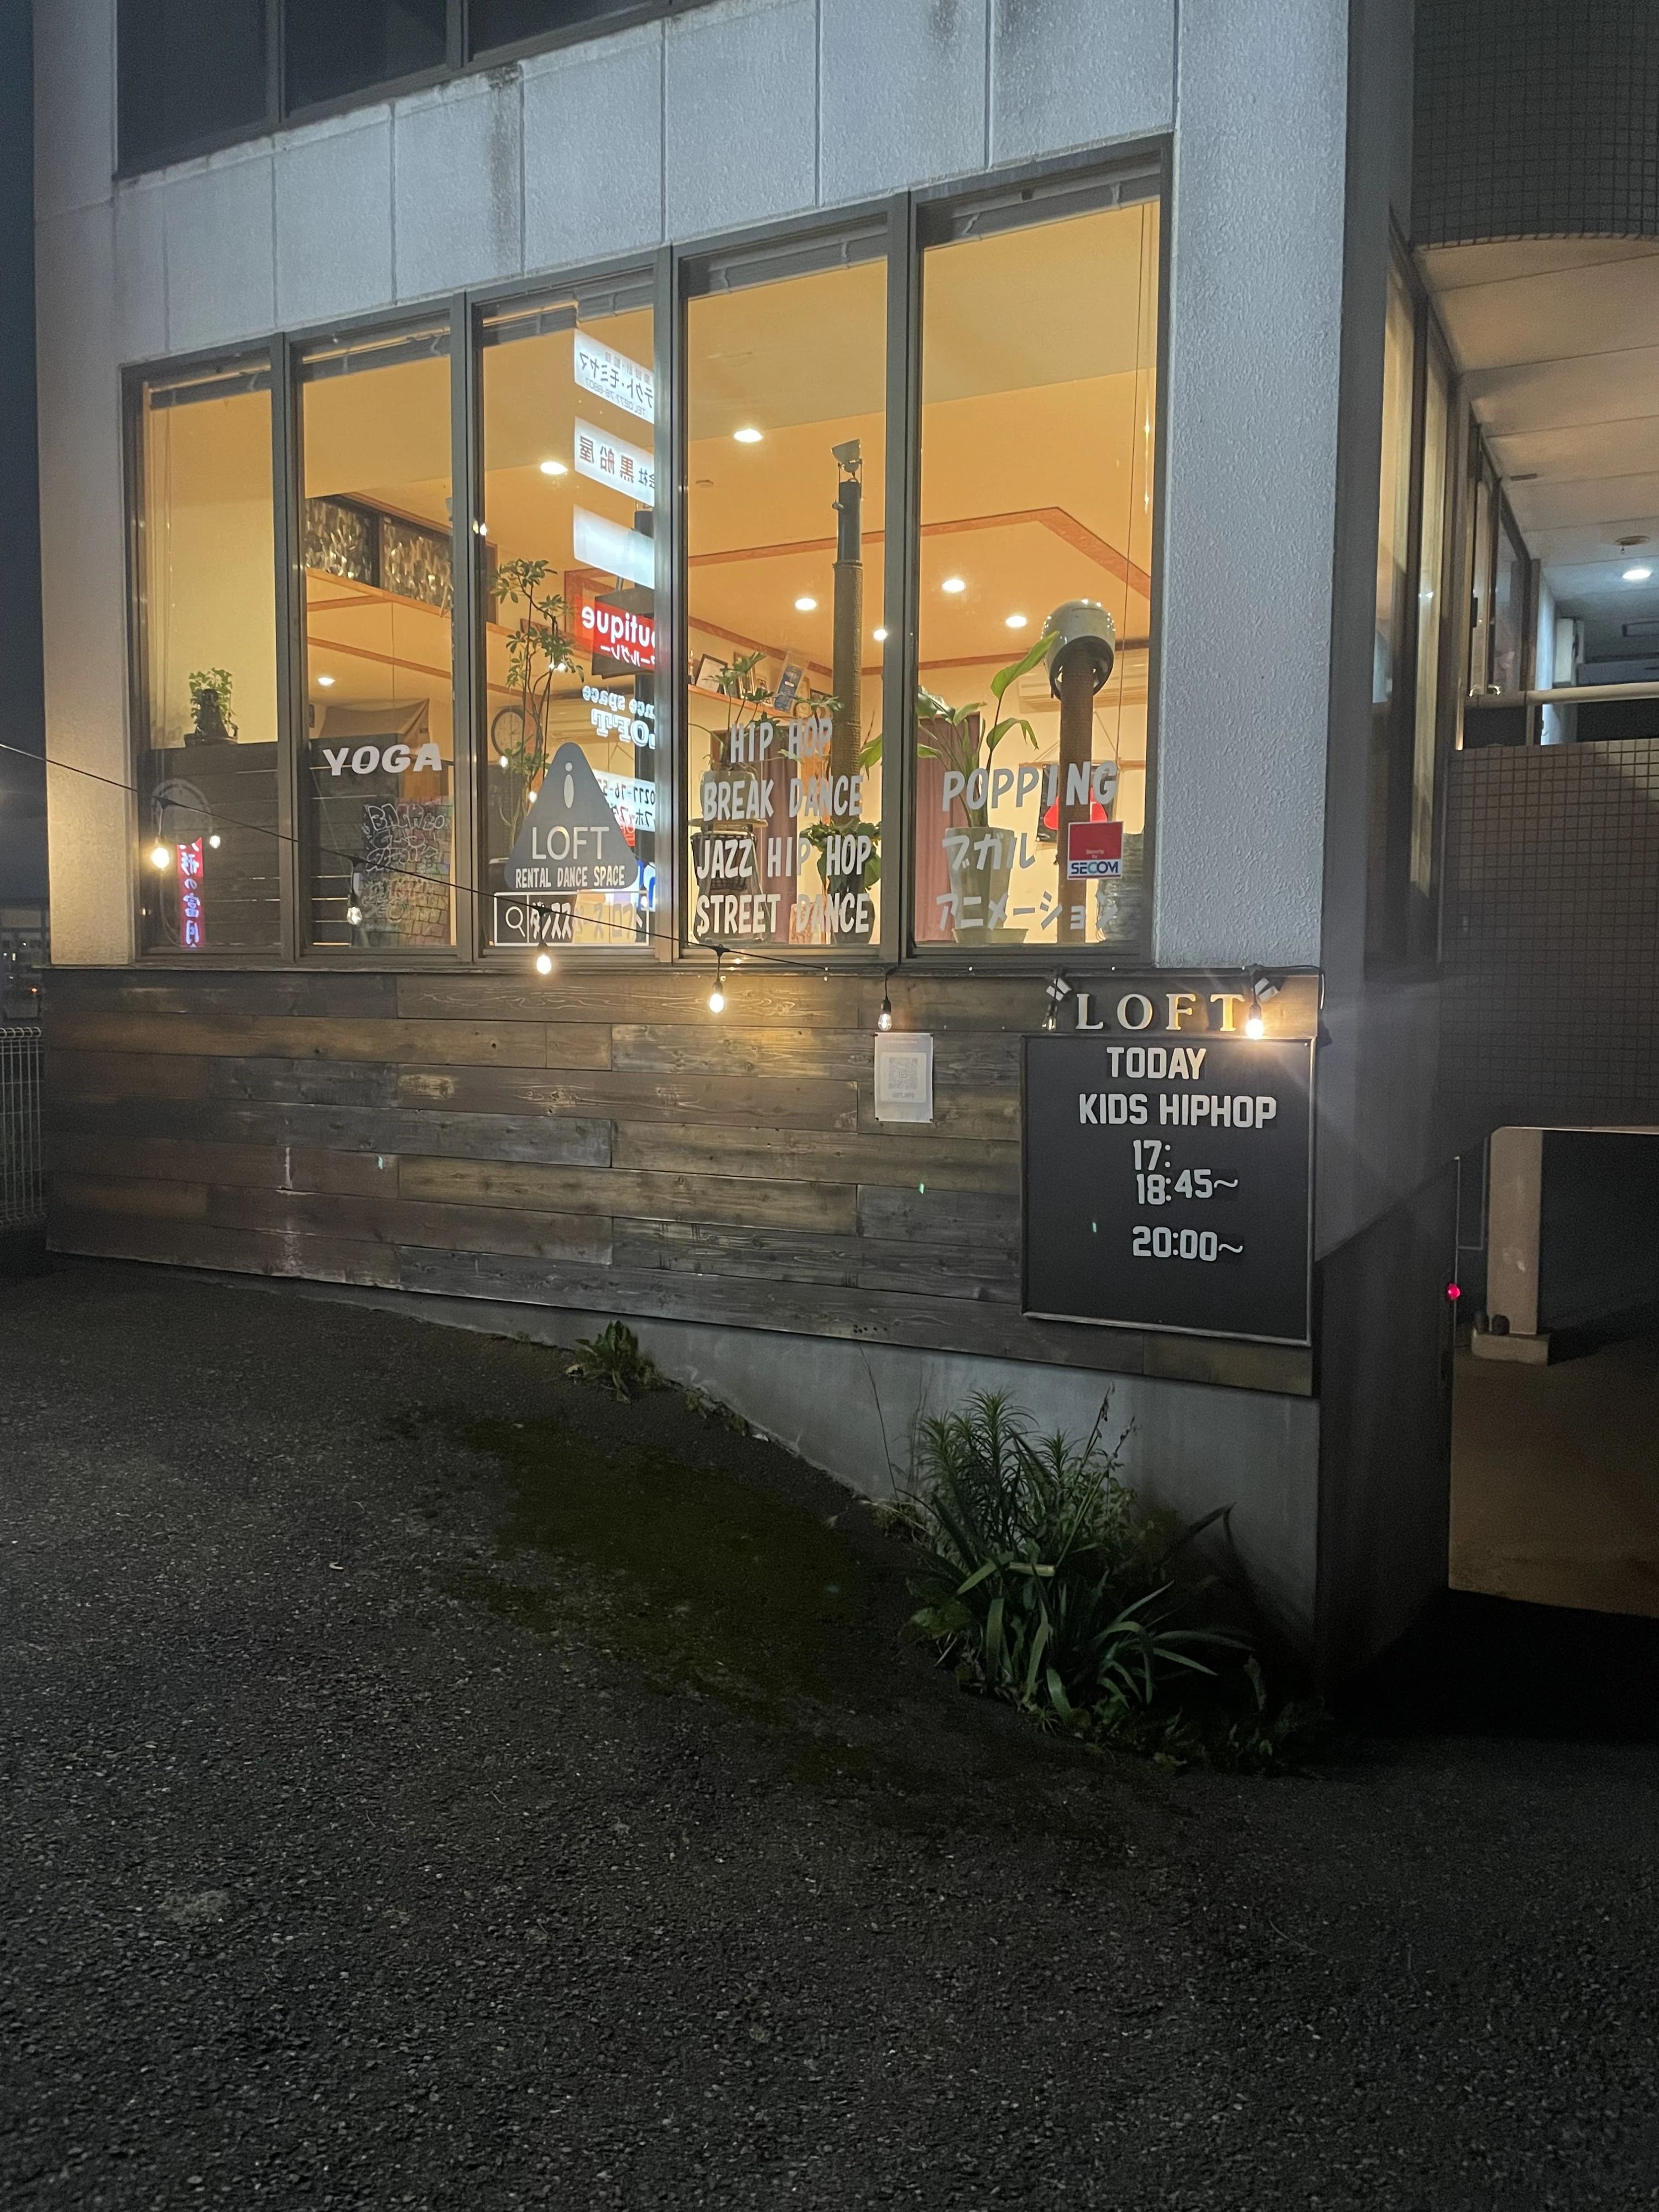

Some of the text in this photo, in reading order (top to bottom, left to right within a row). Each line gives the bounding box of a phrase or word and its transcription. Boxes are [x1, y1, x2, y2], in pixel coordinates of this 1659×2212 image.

[730, 717, 833, 763] HIP HOP
[323, 743, 443, 776] YOGA
[703, 775, 863, 821] BREAK DANCE
[942, 760, 1118, 812] POPPING
[531, 826, 609, 860] LOFT
[697, 835, 872, 879] JAZZ HIP HOP
[942, 832, 1036, 871] ブガル
[515, 865, 625, 888] RENTAL DANCE SPACE
[1071, 860, 1119, 875] SECOM
[696, 893, 870, 935] STREET DANCE
[936, 890, 1118, 931] アニメーション
[1076, 992, 1245, 1032] LOFT
[1107, 1046, 1207, 1080] TODAY
[1079, 1093, 1277, 1129] KIDS HIPHOP
[1133, 1139, 1171, 1171] 17:
[1132, 1225, 1243, 1262] 20:00~
